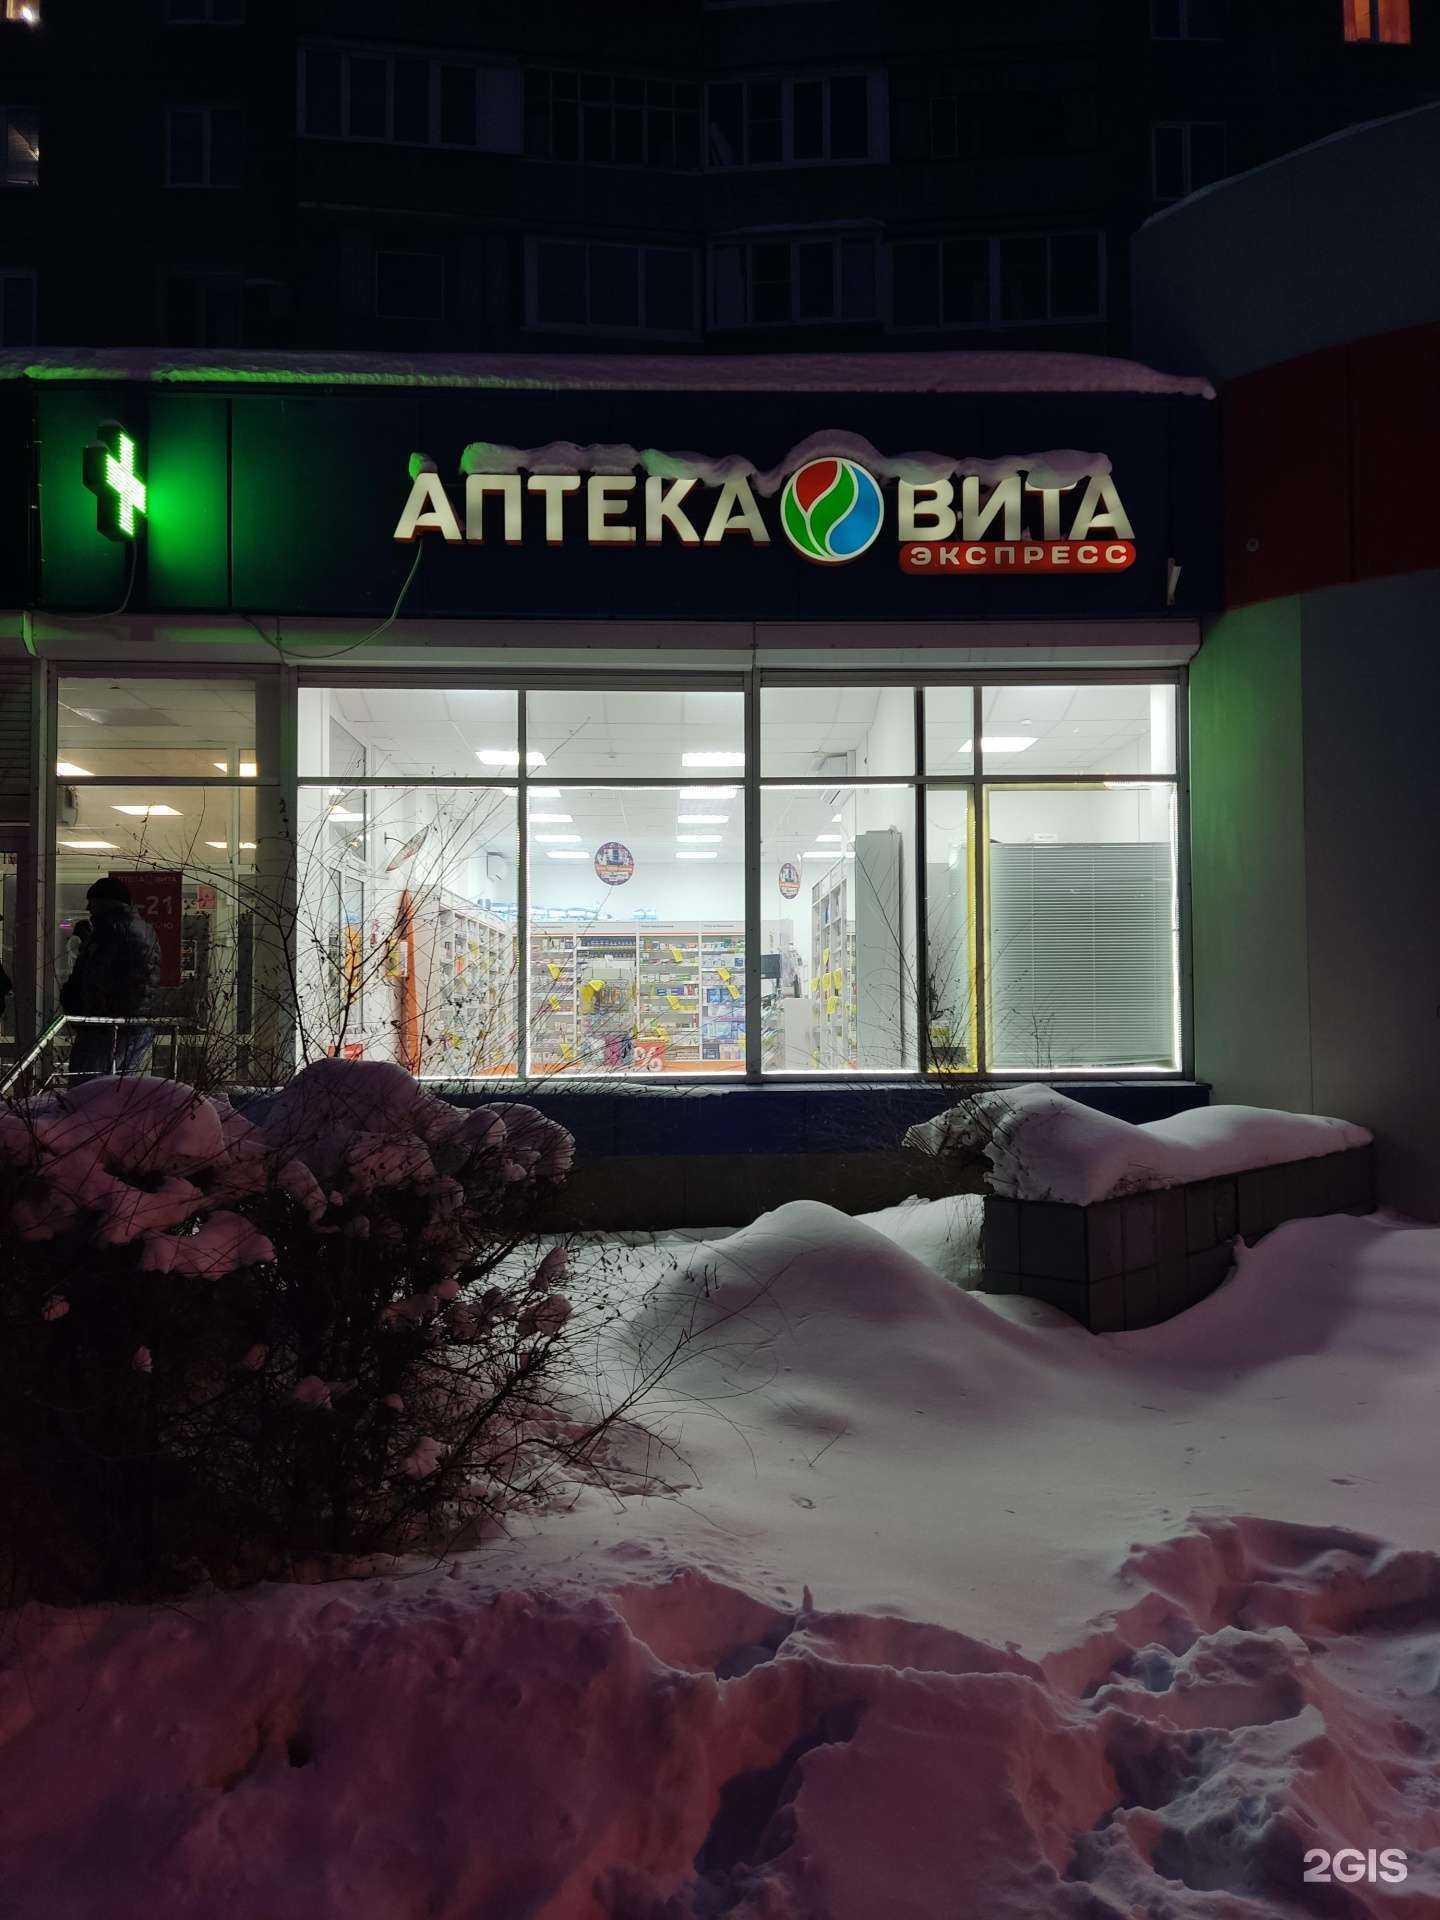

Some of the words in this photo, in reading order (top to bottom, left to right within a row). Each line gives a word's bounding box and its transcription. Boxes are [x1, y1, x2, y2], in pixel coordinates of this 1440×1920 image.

[393, 472, 771, 544] АПТЕКА
[898, 474, 1136, 541] ВИТА
[910, 545, 1128, 566] ЭКСПРЕСС
